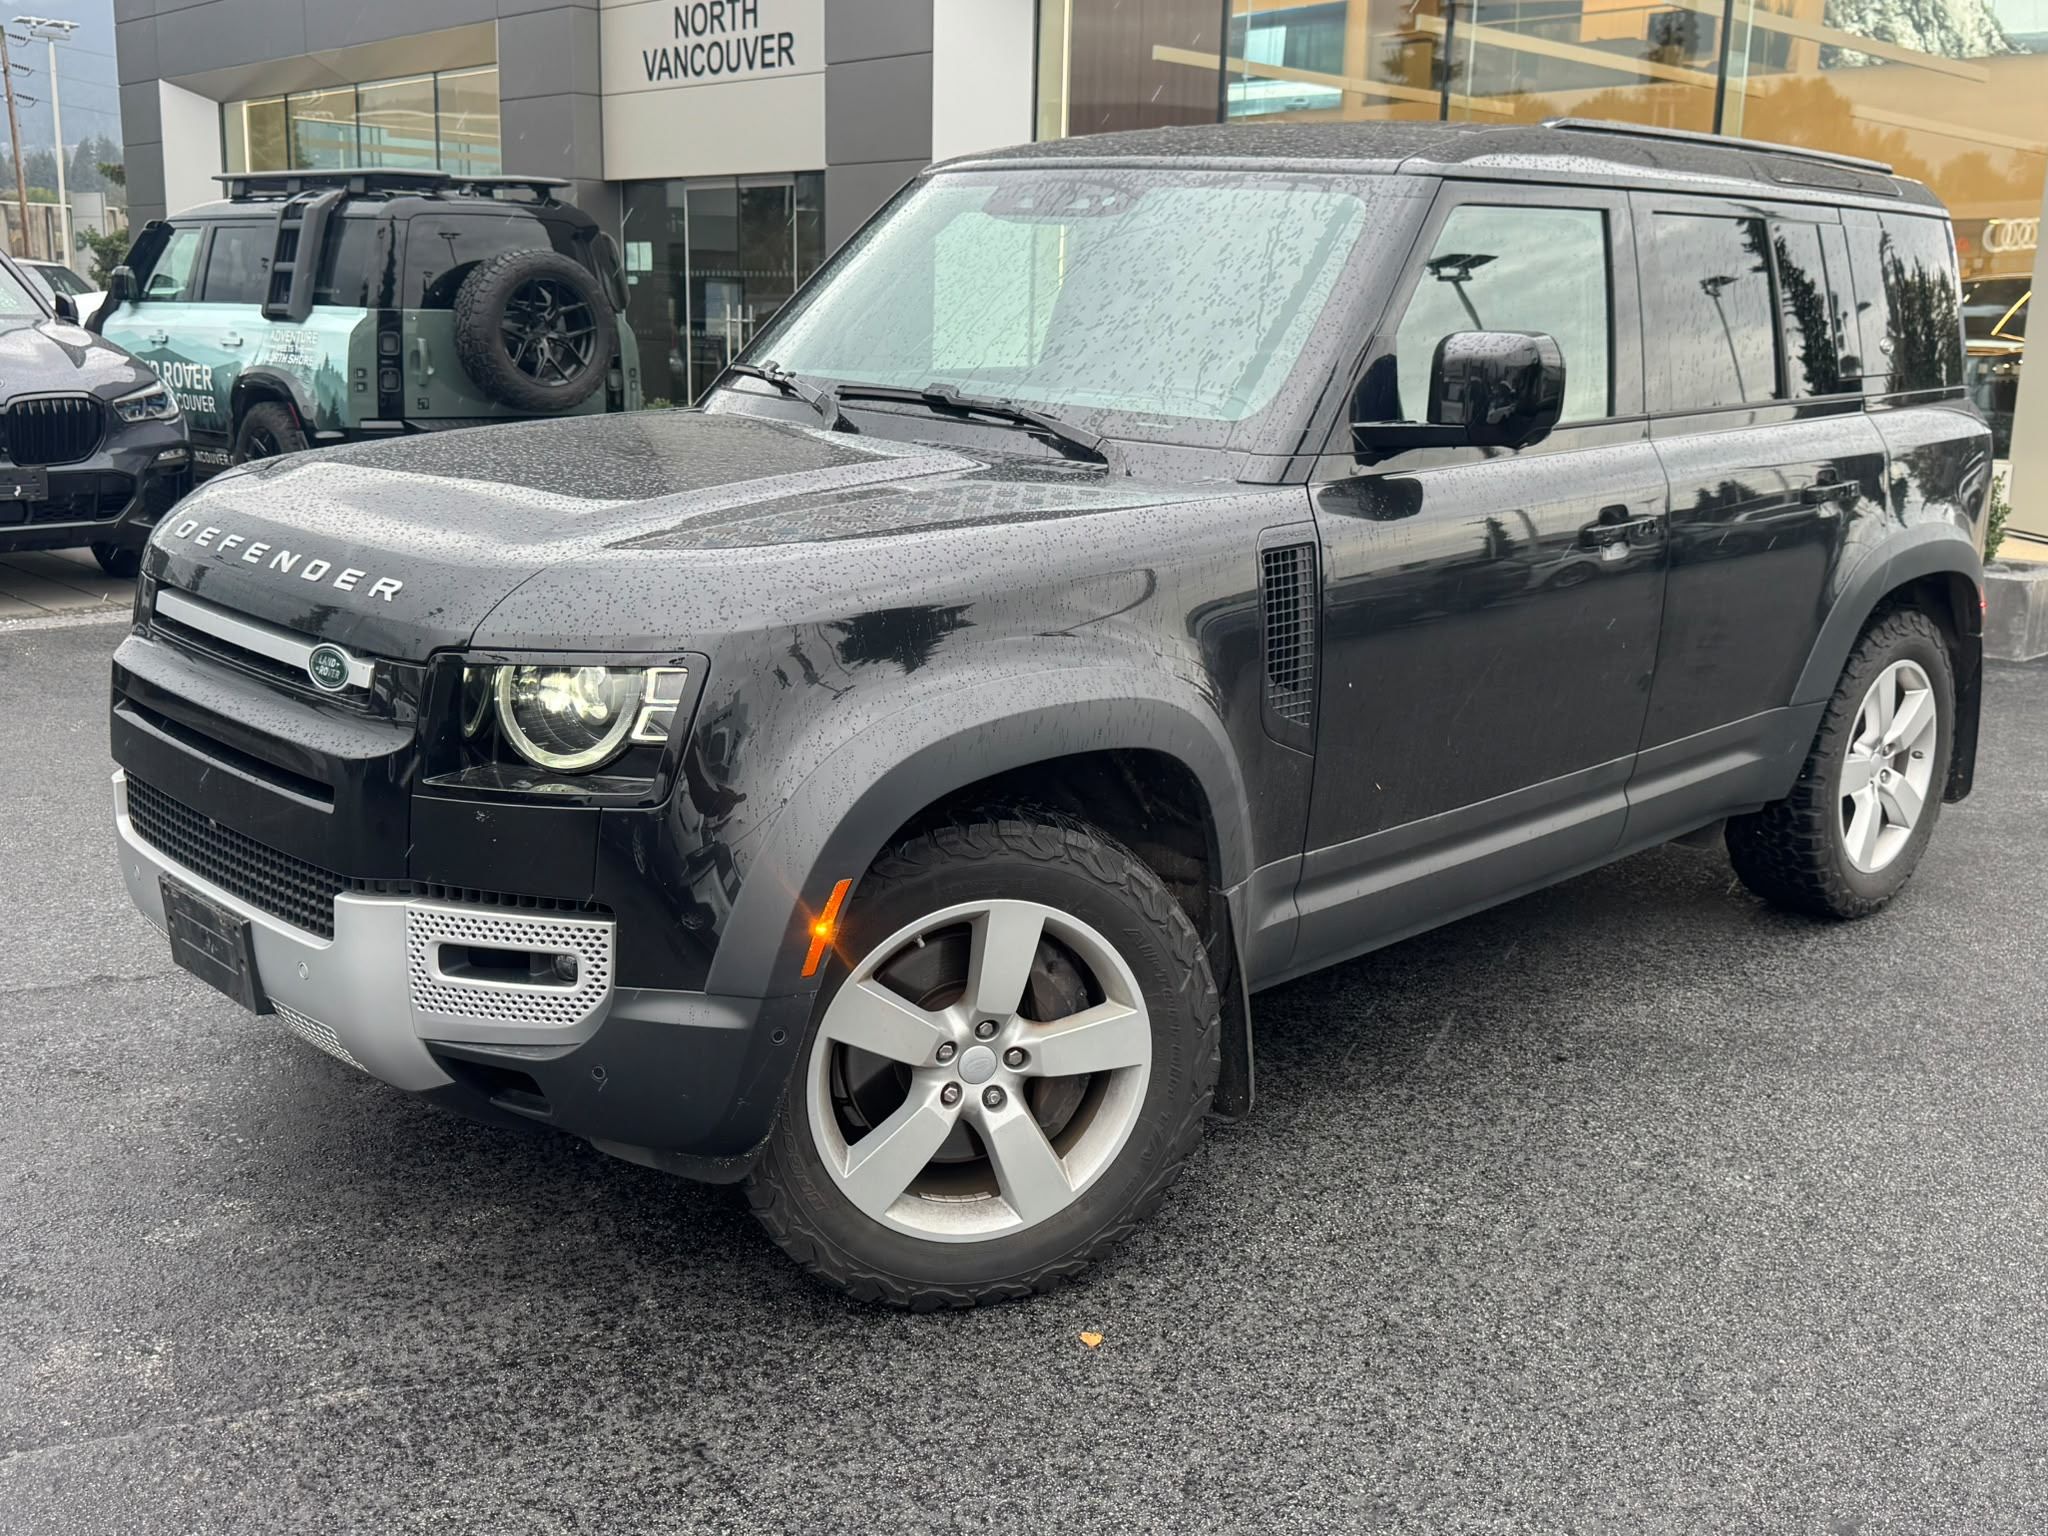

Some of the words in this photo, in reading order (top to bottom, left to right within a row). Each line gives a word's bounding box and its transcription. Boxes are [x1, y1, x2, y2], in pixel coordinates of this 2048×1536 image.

[674, 0, 758, 39] NORTH
[642, 31, 795, 82] VANCOUVER
[163, 361, 213, 391] ROVER
[177, 393, 216, 413] COUVER
[175, 519, 403, 602] DEFENDER
[318, 665, 341, 680] ROVER
[319, 655, 337, 668] LAND
